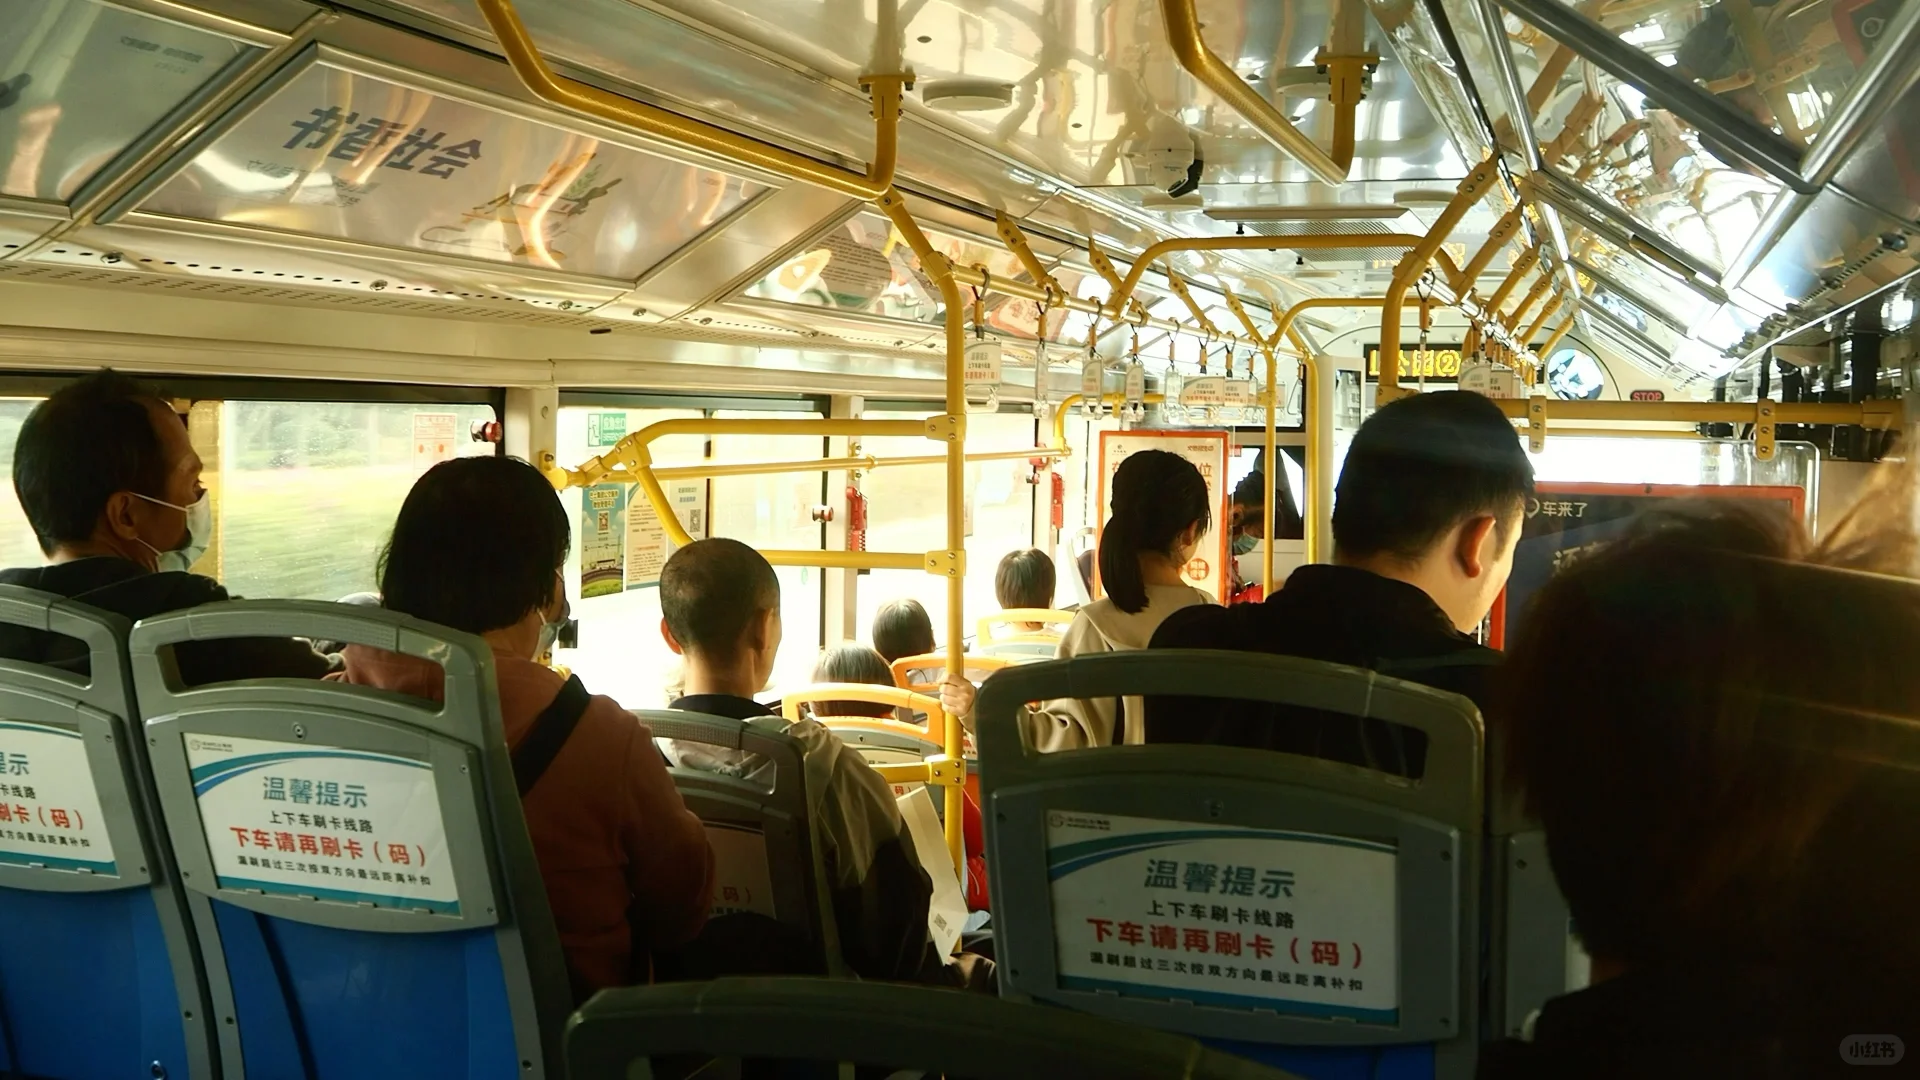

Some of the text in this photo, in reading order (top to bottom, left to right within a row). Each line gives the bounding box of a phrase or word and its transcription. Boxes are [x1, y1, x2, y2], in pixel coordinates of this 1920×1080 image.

[282, 106, 482, 179] 书香社会
[1633, 391, 1662, 402] STOP
[1542, 501, 1588, 518] 车来了
[263, 776, 368, 808] 温馨提示
[269, 811, 373, 833] 上下车刷卡线路
[229, 827, 426, 867] 下车请再刷卡（码）
[1144, 859, 1296, 899] 温馨提示
[1147, 900, 1295, 929] 上下车刷卡线路
[1086, 918, 1362, 969] 下车请再刷卡（码）
